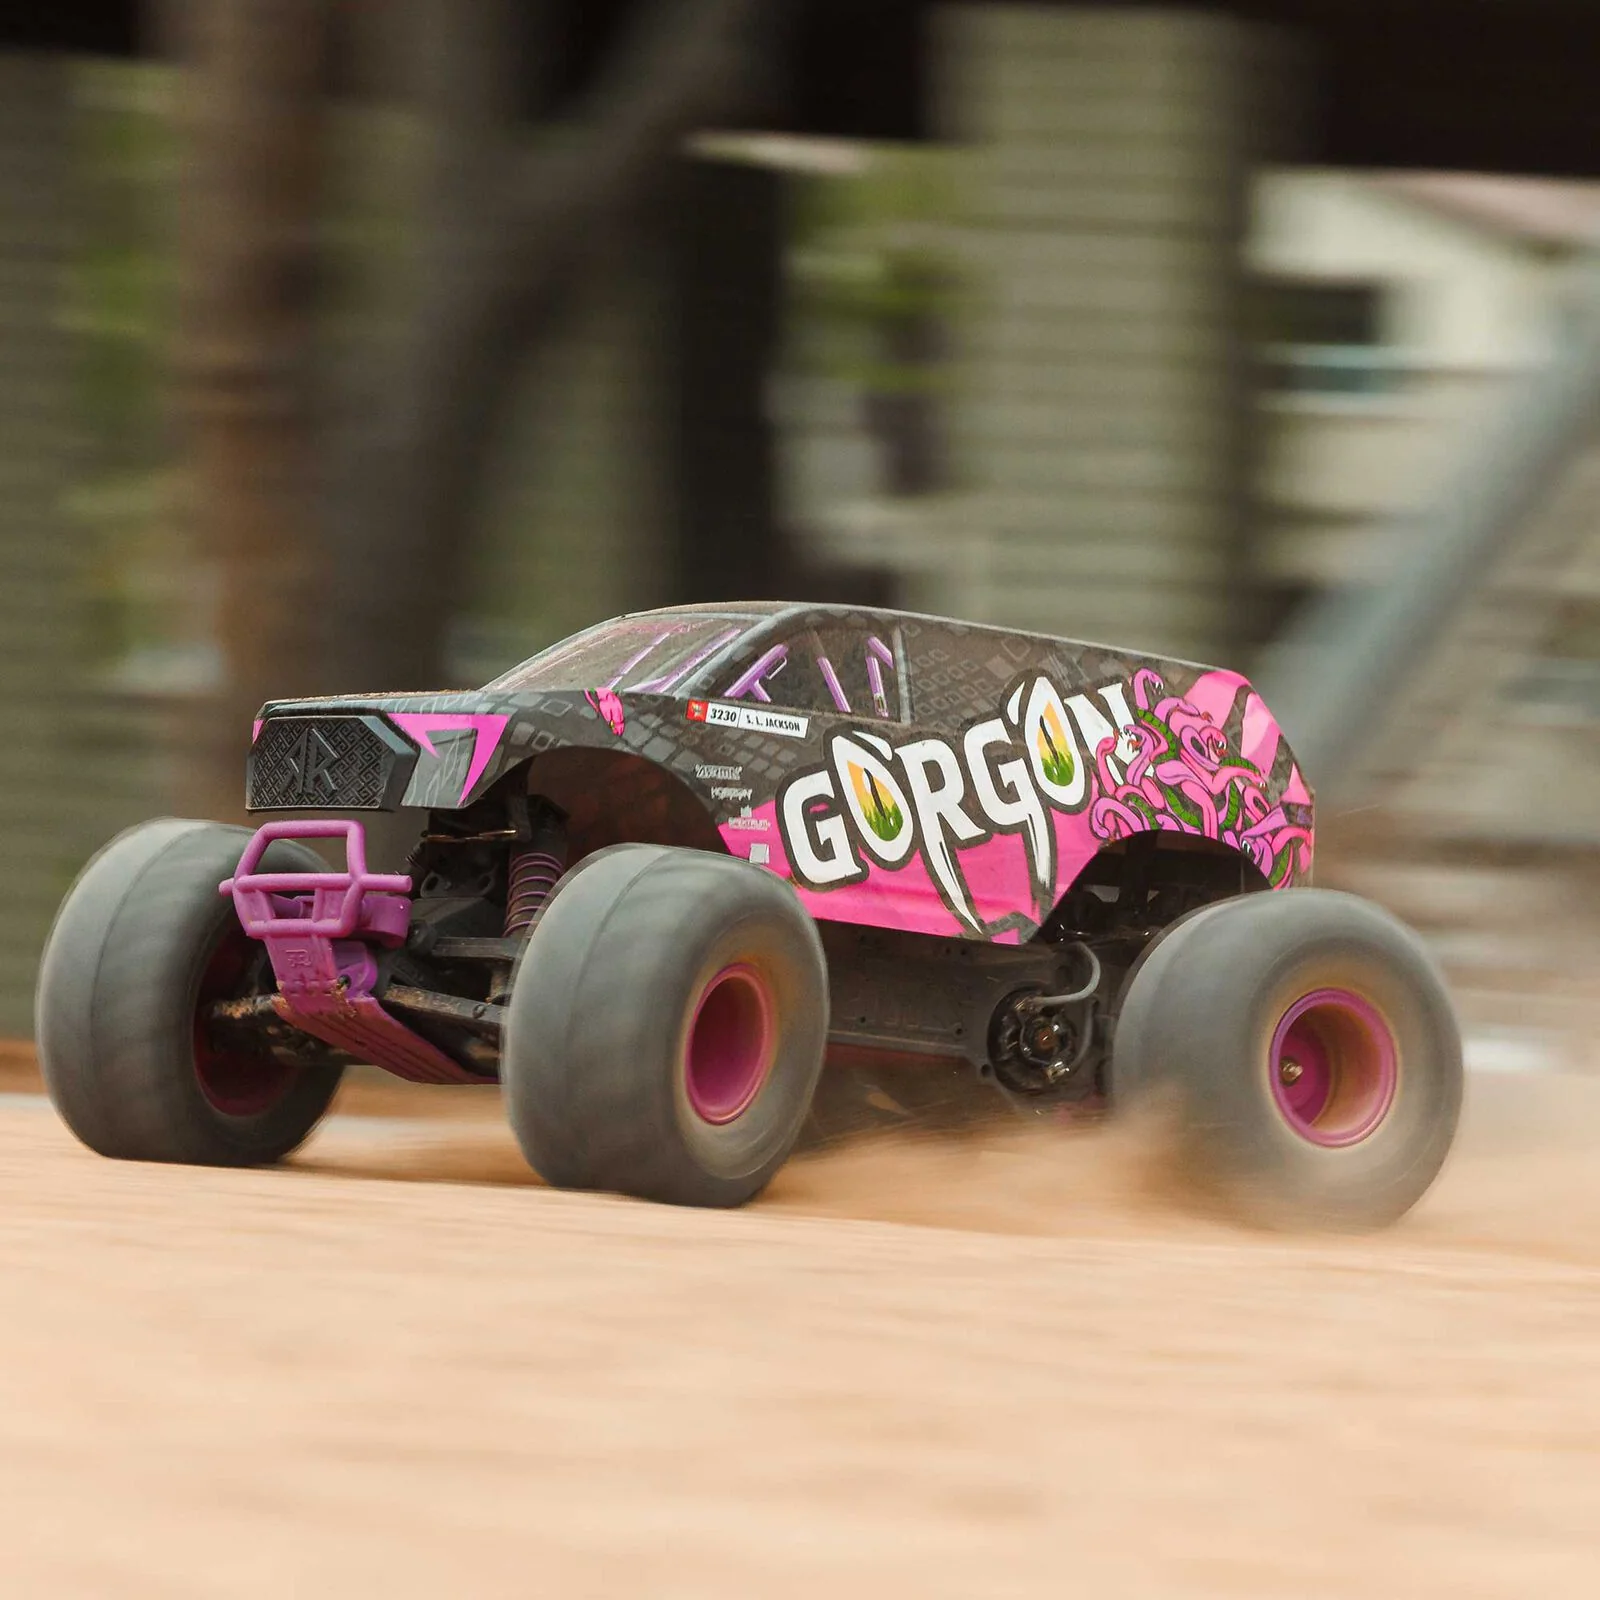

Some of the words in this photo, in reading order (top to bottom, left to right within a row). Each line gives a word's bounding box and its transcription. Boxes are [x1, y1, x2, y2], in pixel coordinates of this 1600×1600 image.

[710, 708, 737, 722] 3230
[765, 717, 801, 732] JACKSON
[783, 676, 1153, 934] GORGON
